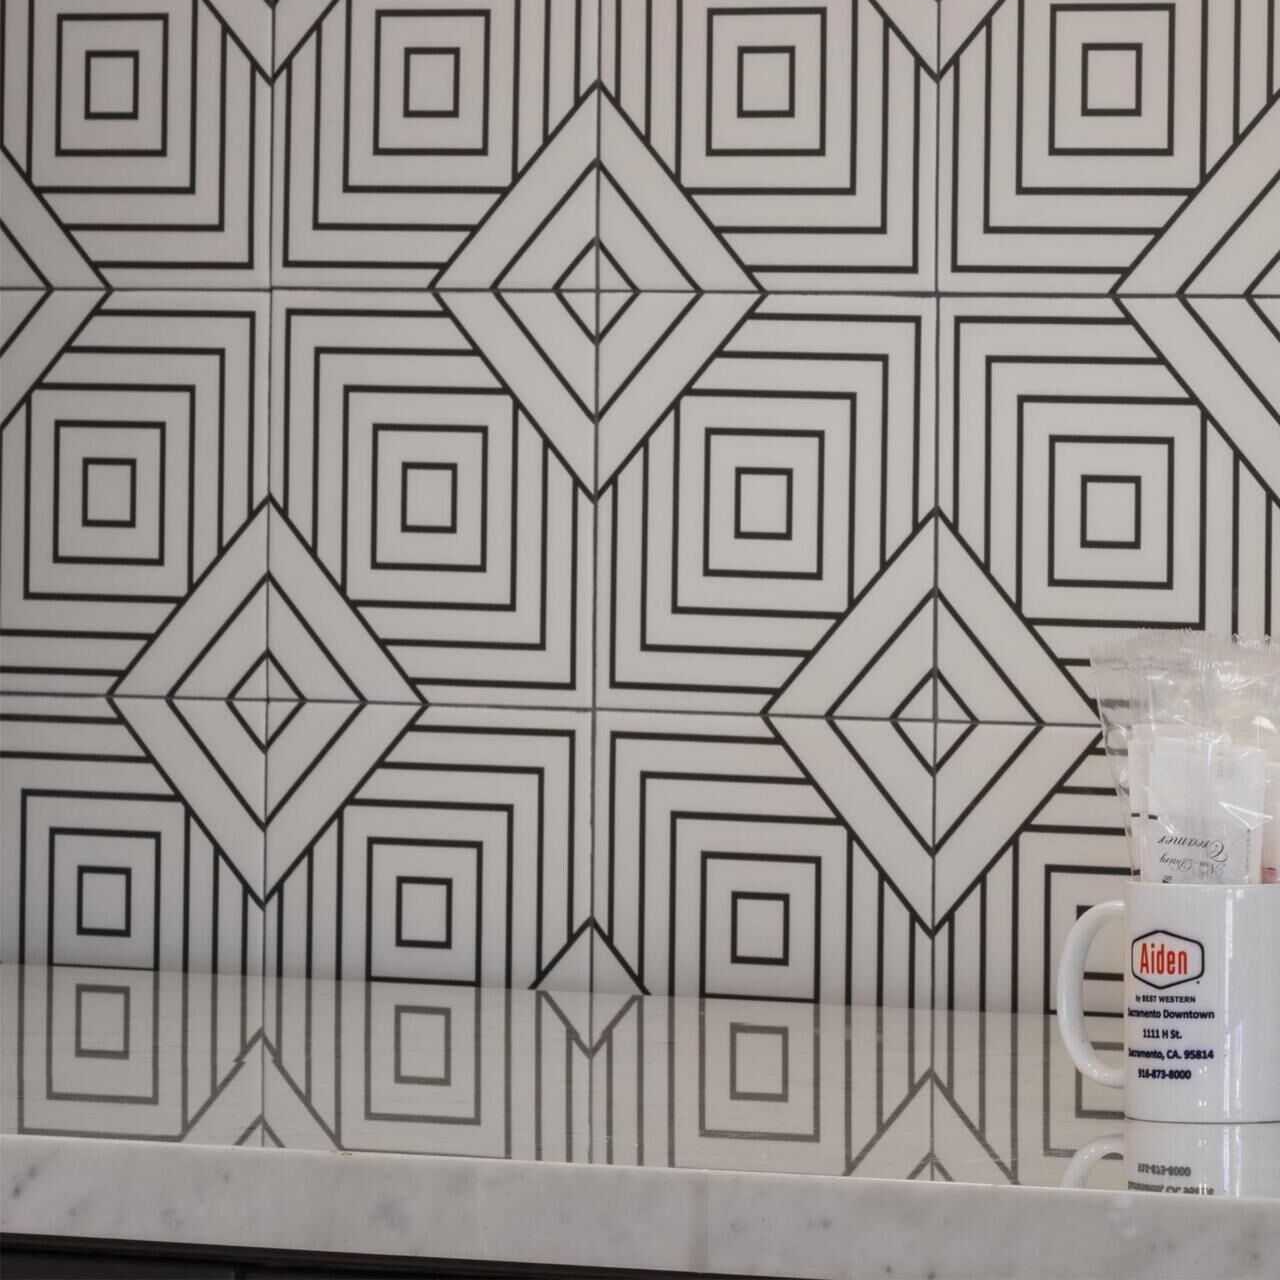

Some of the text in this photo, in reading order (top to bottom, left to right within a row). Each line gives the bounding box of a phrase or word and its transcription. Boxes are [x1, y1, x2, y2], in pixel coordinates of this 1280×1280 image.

[1157, 834, 1229, 863] Creamer
[1140, 943, 1188, 975] Aiden
[1142, 995, 1157, 1003] BEST
[1163, 1009, 1215, 1019] Downtown
[1143, 1029, 1182, 1039] 1111 H St.
[1166, 1050, 1182, 1059] CA.
[1184, 1050, 1214, 1059] 95814
[1138, 1068, 1191, 1079] 916-873-8000
